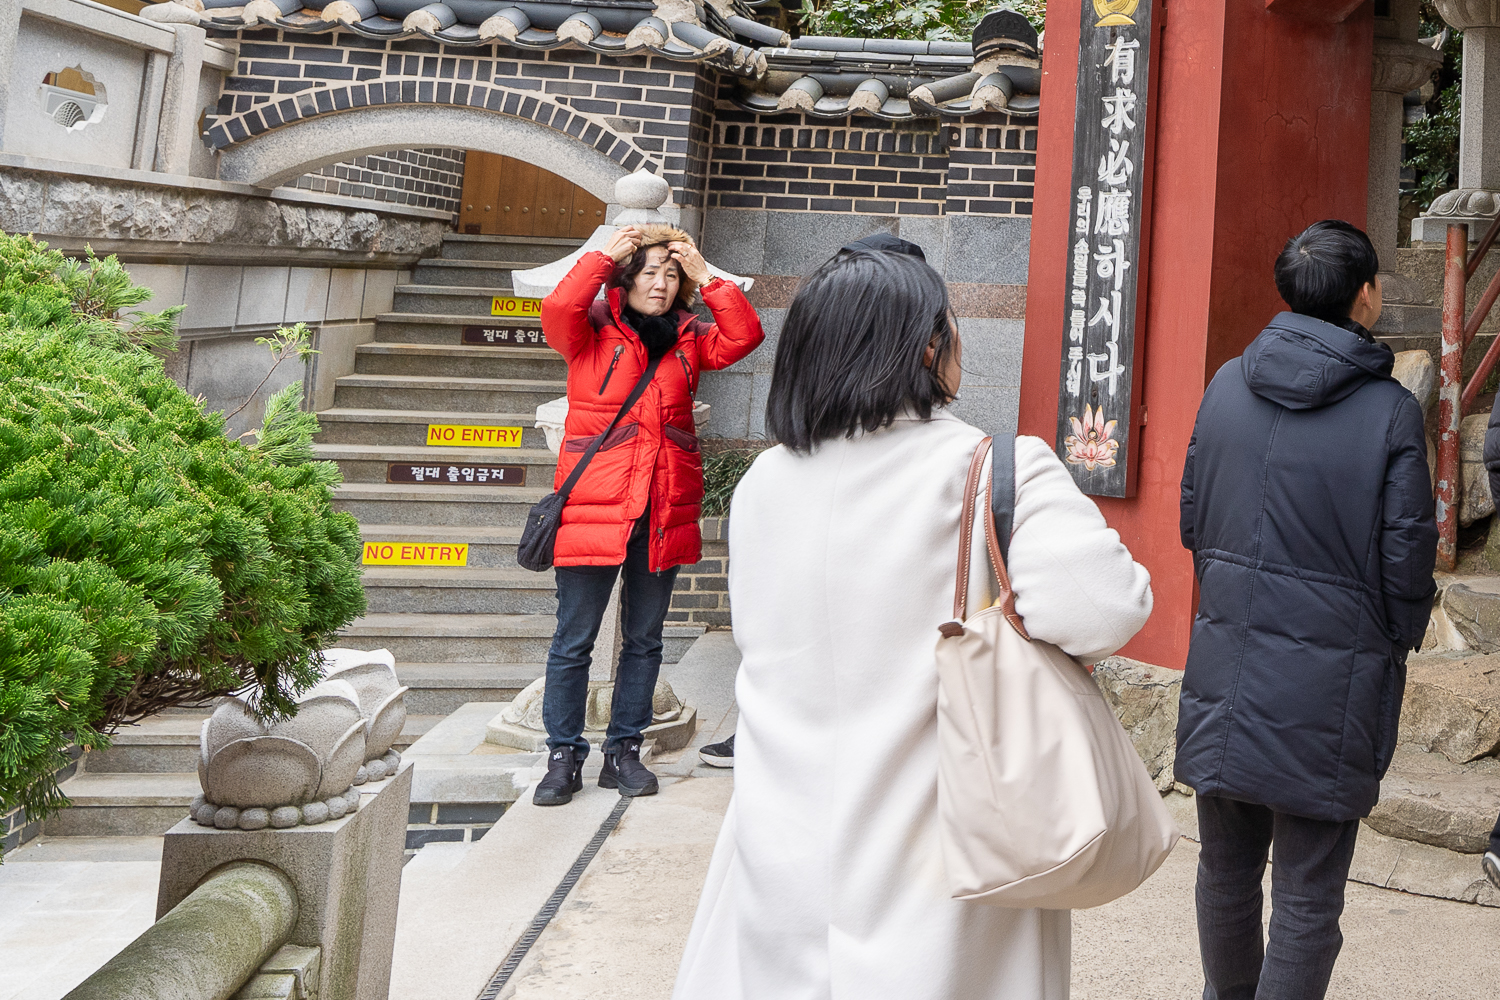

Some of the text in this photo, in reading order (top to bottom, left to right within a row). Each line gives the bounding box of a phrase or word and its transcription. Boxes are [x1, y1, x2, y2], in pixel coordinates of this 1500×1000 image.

[1075, 185, 1093, 235] 우리의
[1086, 36, 1140, 397] 有求必應하시다
[494, 299, 516, 312] NO
[483, 329, 547, 343] 절대 출입
[430, 427, 520, 442] NO ENTRY
[411, 466, 504, 482] 절대 출입금지
[366, 545, 465, 561] NO ENTRY
